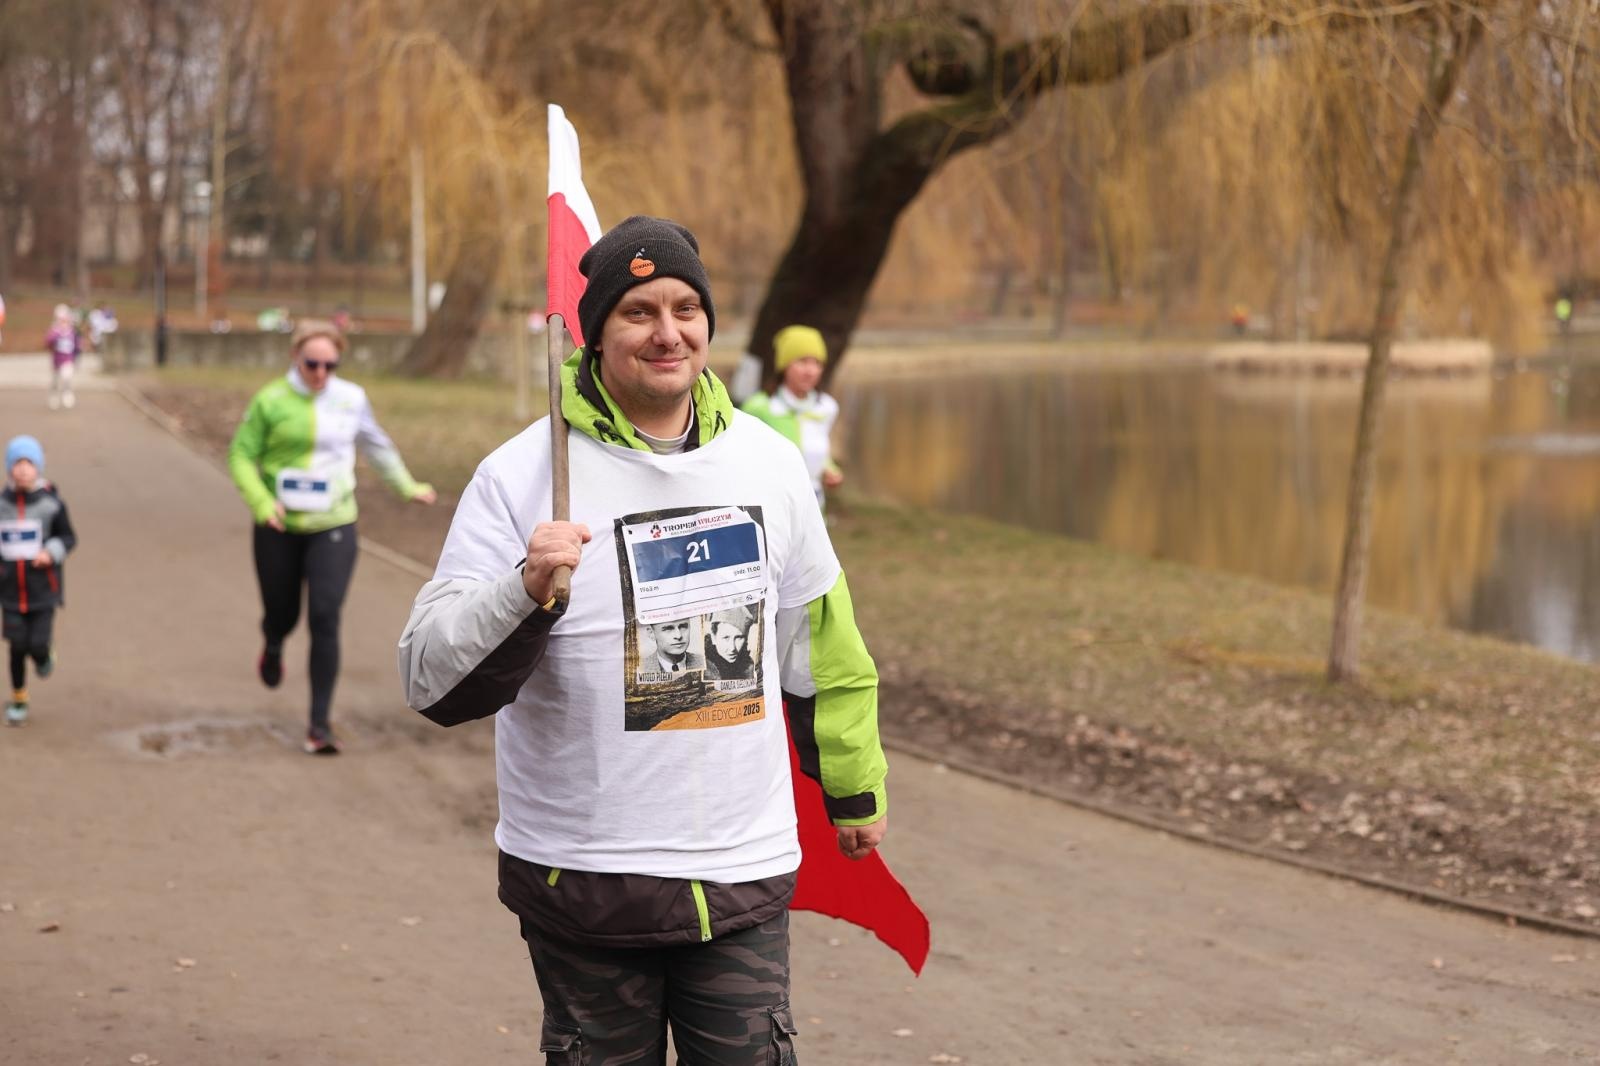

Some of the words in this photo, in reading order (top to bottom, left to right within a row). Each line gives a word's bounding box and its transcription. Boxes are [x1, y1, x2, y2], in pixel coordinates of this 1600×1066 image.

[663, 520, 697, 533] TROPEM
[686, 539, 710, 563] 21
[695, 710, 710, 722] XIII
[711, 706, 743, 721] EDYCJA
[743, 702, 760, 716] 2025
